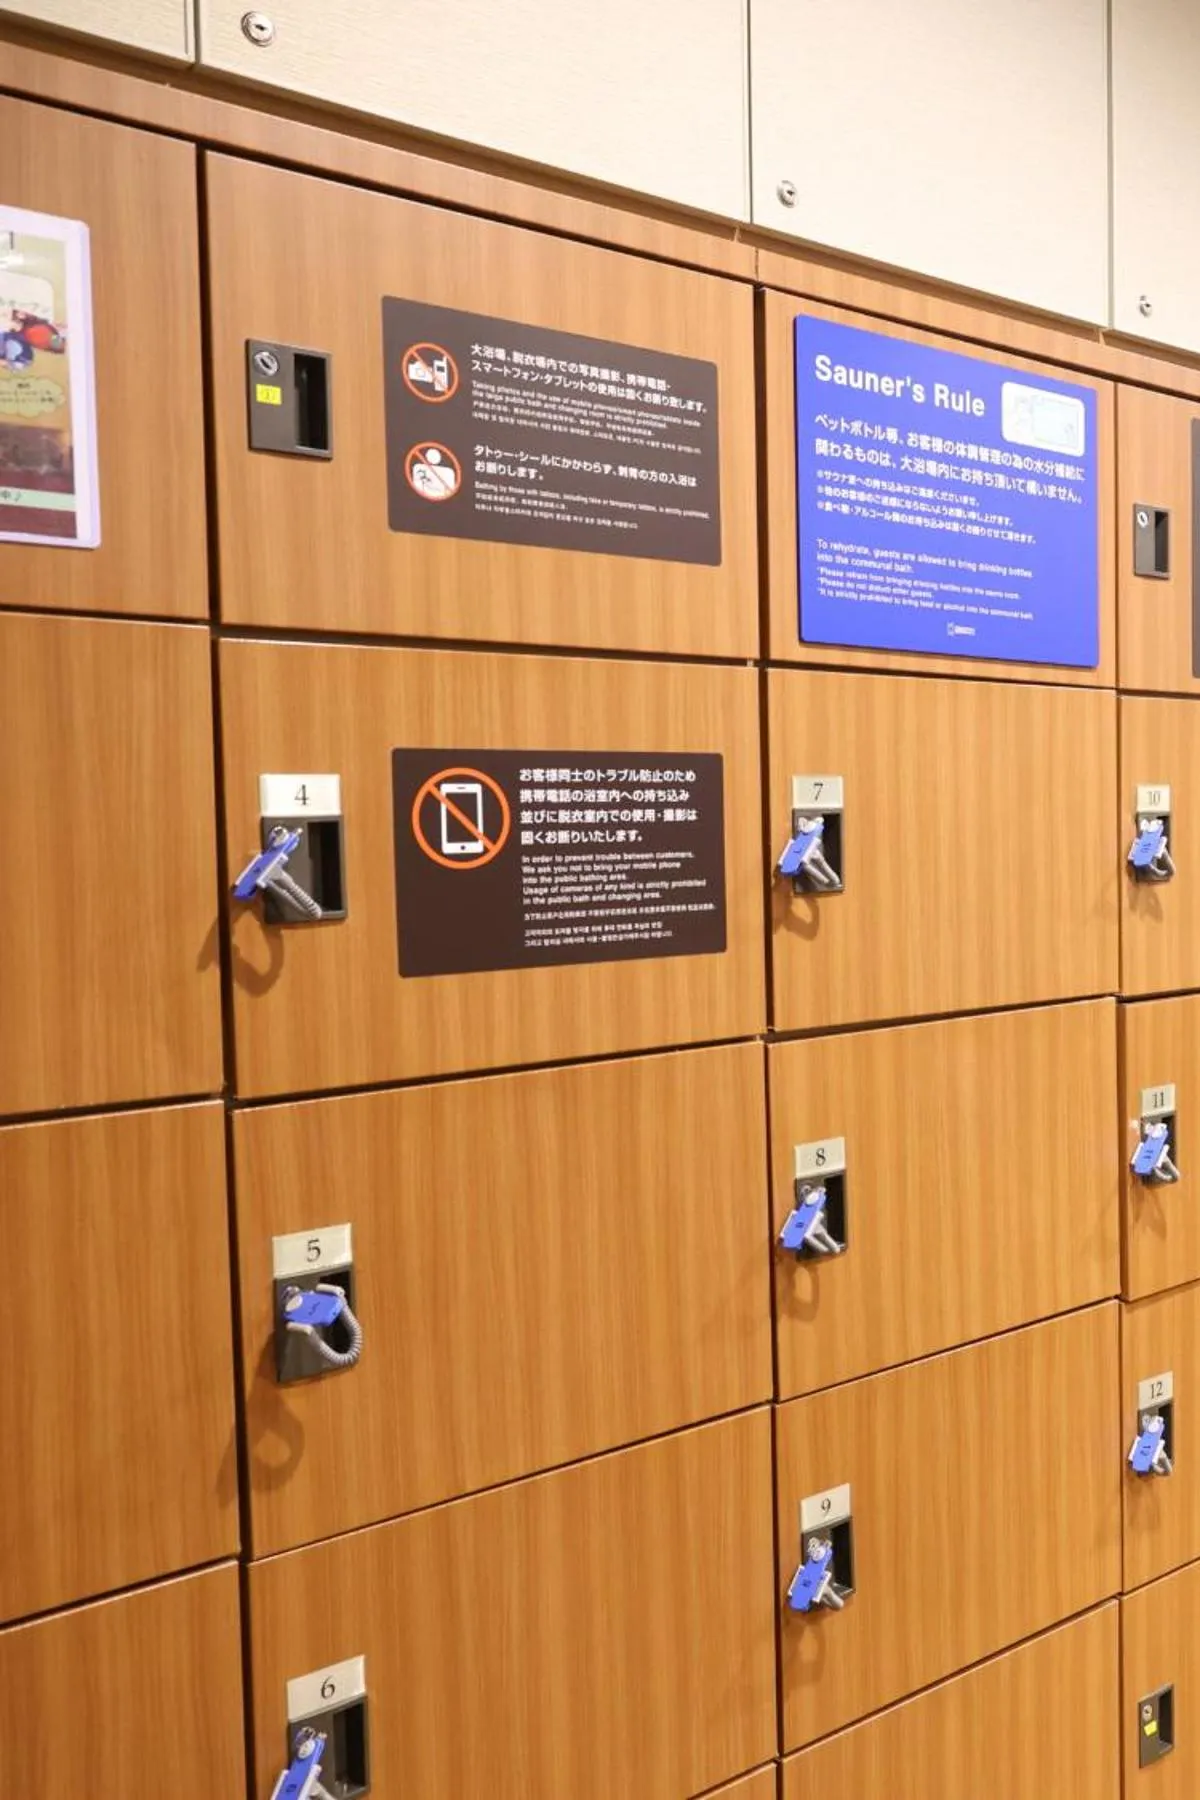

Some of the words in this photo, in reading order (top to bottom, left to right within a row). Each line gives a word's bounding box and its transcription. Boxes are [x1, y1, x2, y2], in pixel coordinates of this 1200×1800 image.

[815, 354, 924, 404] Sauner's
[933, 382, 985, 416] Rule
[294, 784, 309, 806] 4
[813, 782, 824, 802] 7
[1147, 790, 1161, 807] 10
[531, 855, 552, 863] order
[564, 853, 593, 862] prevent
[622, 851, 653, 860] between
[593, 863, 612, 871] bring
[522, 886, 548, 894] Usage
[1152, 1091, 1165, 1109] 11
[814, 1147, 826, 1167] 8
[306, 1238, 321, 1262] 5
[1150, 1380, 1163, 1400] 12
[820, 1497, 831, 1516] 9
[321, 1675, 335, 1700] 6
